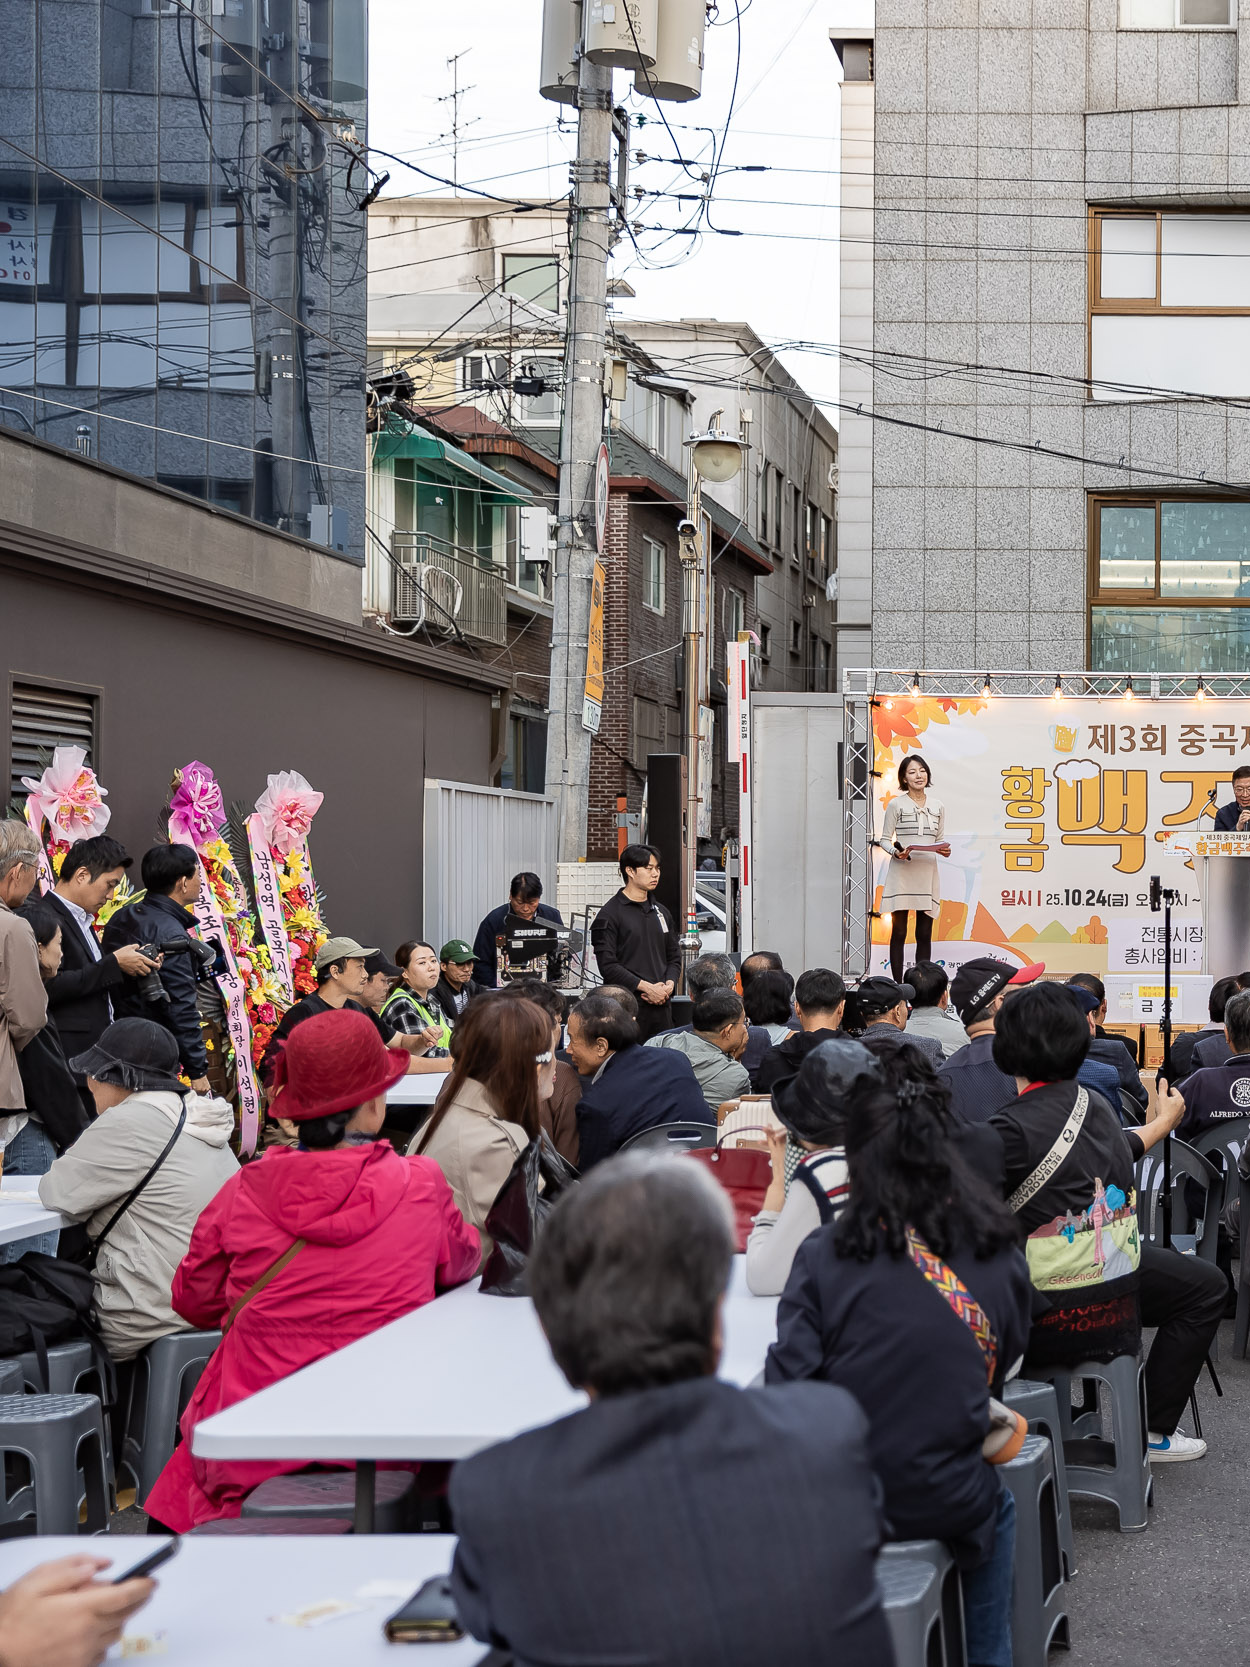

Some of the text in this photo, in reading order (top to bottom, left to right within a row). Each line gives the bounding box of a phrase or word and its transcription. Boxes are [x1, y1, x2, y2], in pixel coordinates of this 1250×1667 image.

[1087, 724, 1167, 756] 제3회
[1000, 766, 1052, 873] 황금
[255, 851, 275, 913] 남성역
[1000, 889, 1032, 907] 일시
[513, 928, 548, 937] SHURE
[1141, 926, 1203, 943] 전통시장
[970, 995, 980, 1006] LG
[978, 980, 995, 997] 올레드
[991, 973, 1001, 983] TV
[231, 995, 245, 1048] 상인회장
[1209, 1110, 1243, 1118] ALFREDO
